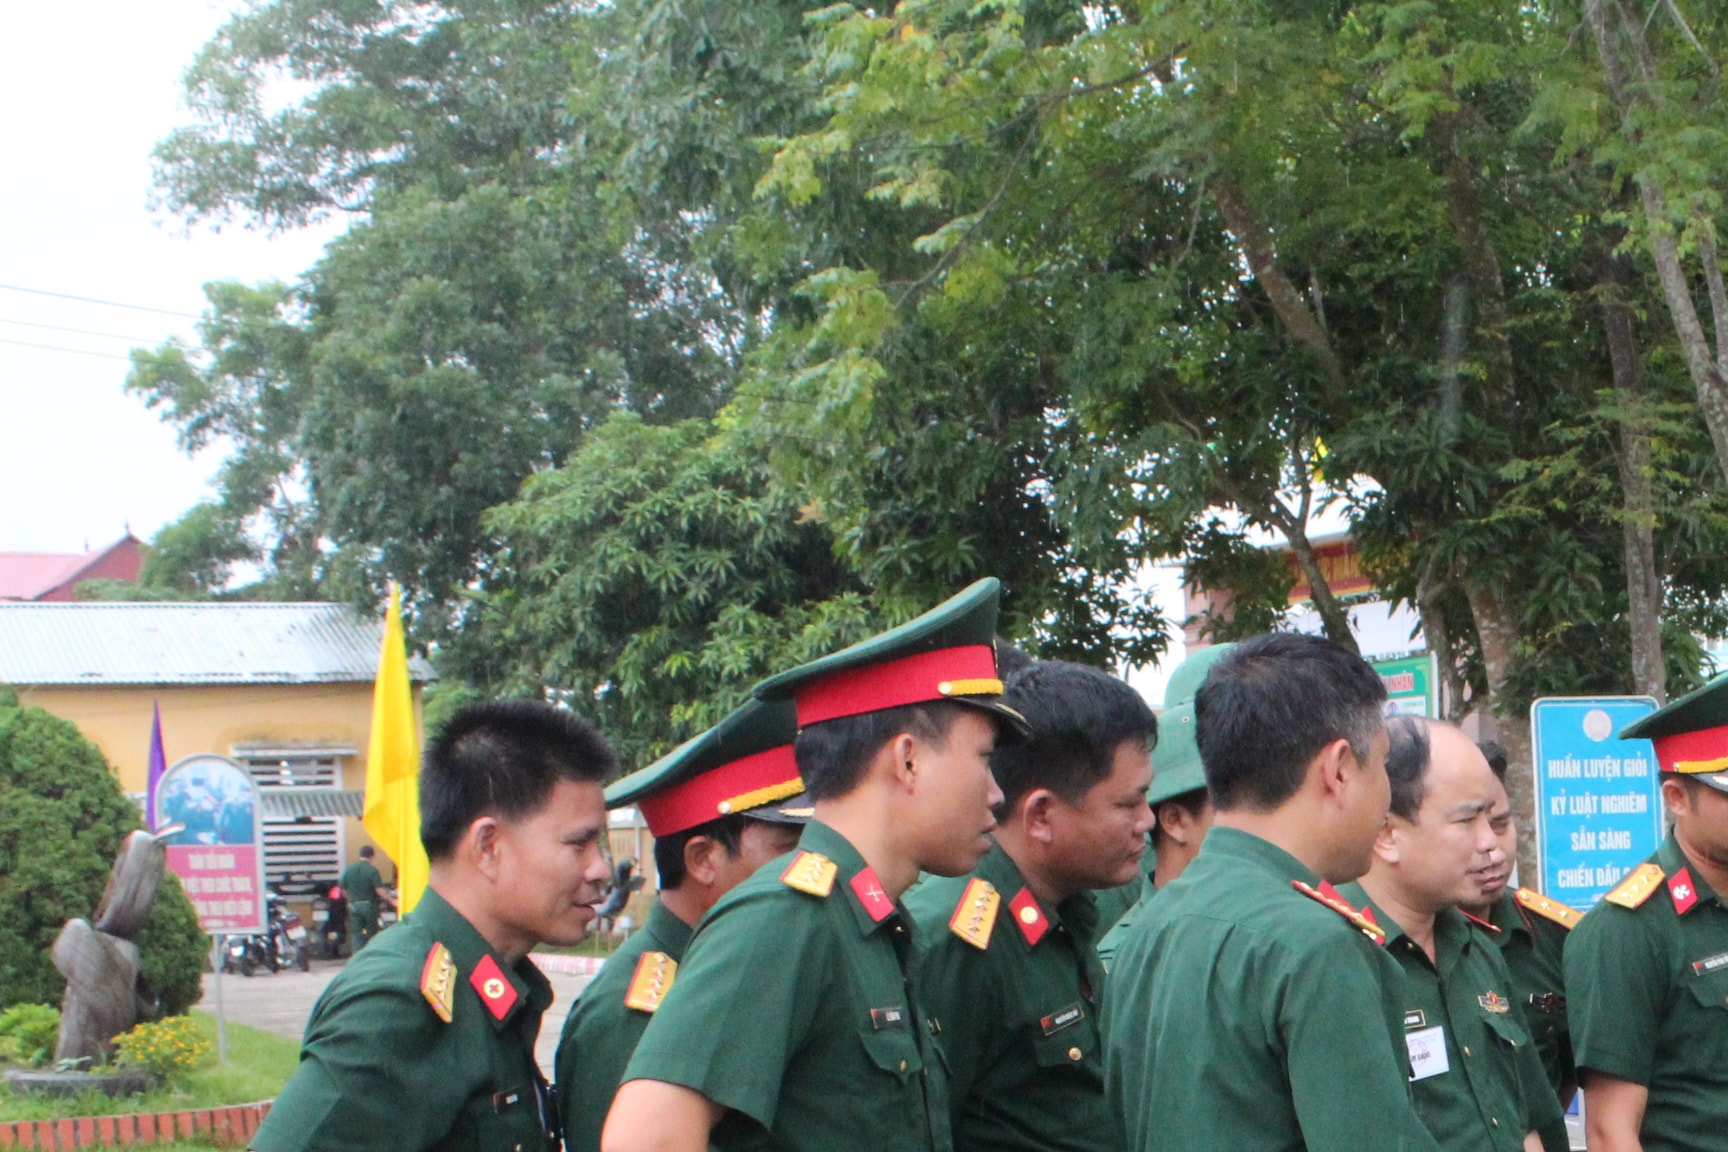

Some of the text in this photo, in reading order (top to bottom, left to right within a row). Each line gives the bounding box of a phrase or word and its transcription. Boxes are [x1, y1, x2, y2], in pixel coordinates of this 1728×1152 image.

[1548, 751, 1648, 781] HUẤN LUYỆN GIỎI
[1551, 788, 1647, 819] KỶ LUẬT NGHIÊM
[1599, 828, 1632, 850] SÀNG
[1557, 861, 1594, 888] CHIẾN
